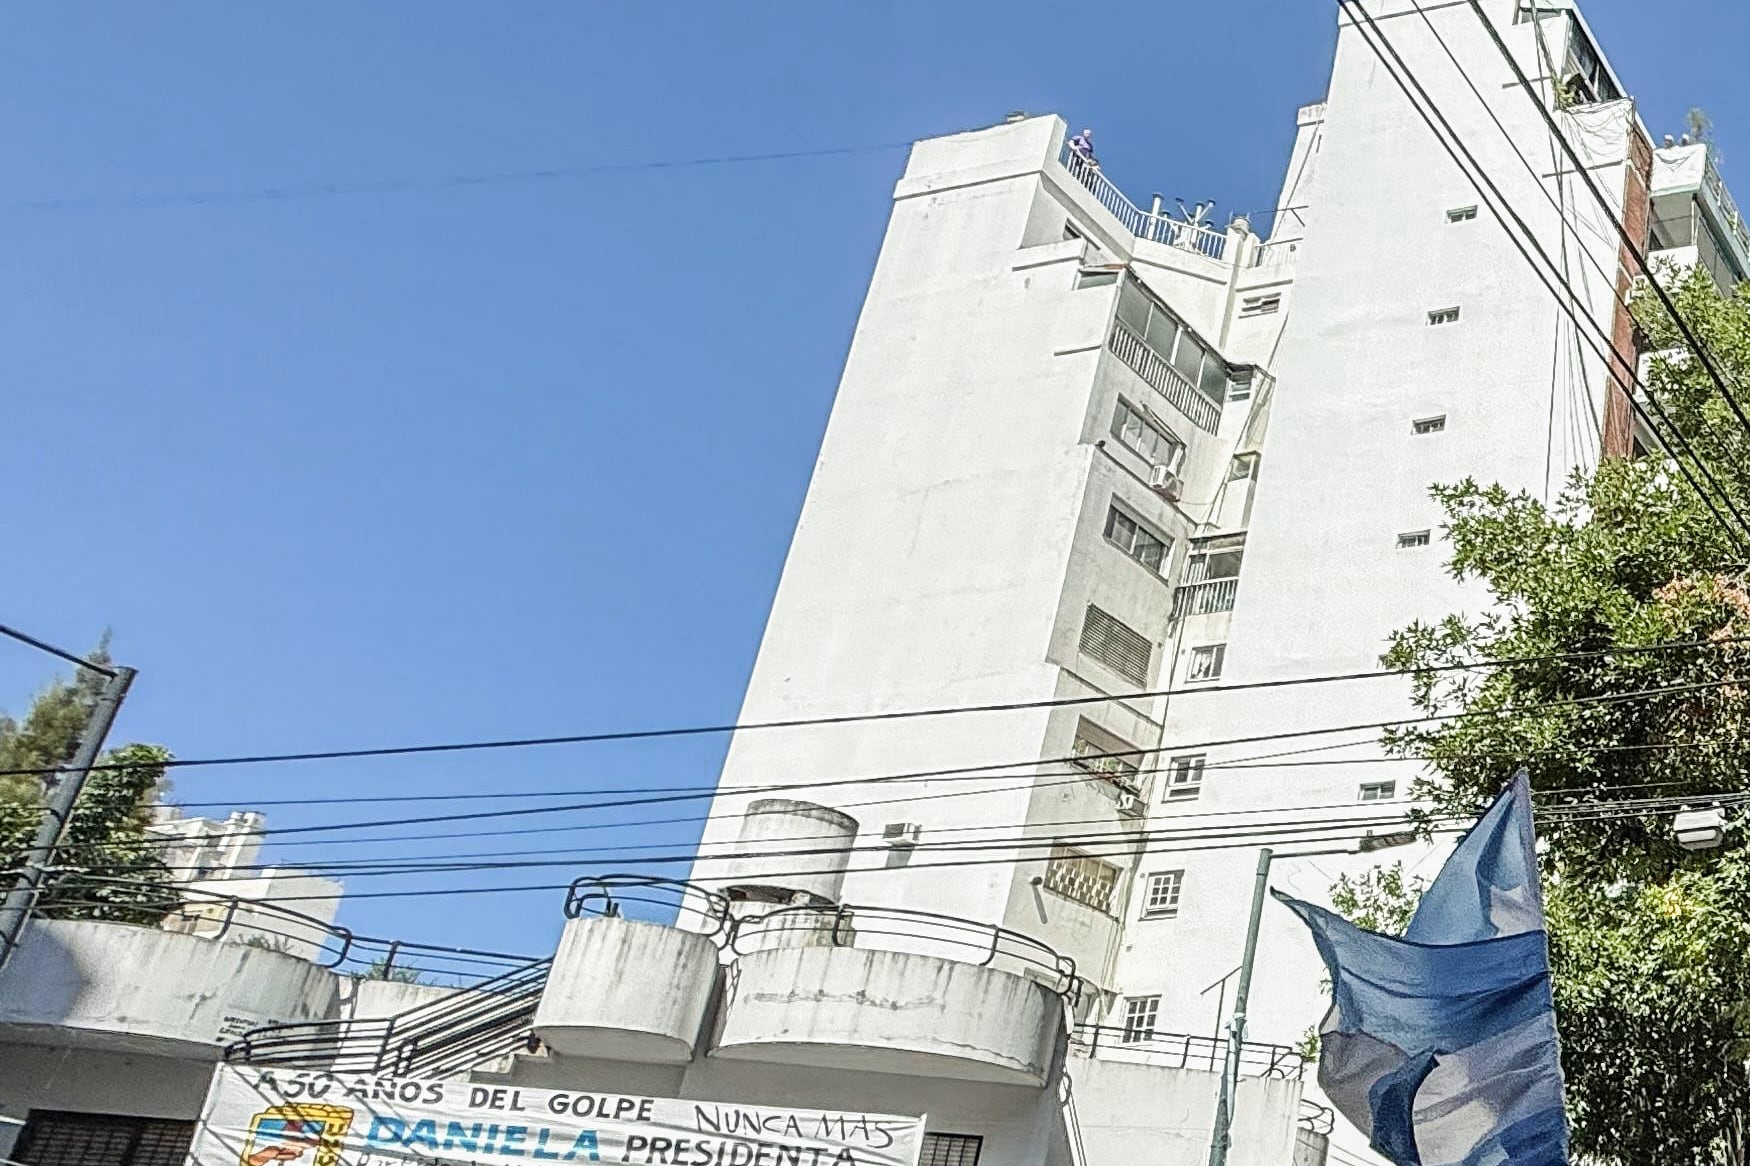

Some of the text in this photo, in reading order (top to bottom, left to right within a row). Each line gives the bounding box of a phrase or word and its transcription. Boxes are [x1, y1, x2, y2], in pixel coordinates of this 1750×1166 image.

[284, 1073, 334, 1098] 50
[468, 1088, 526, 1112] DEL
[548, 1093, 655, 1122] GOLPE
[694, 1104, 801, 1138] NUNCA
[366, 1115, 600, 1161] DANIELA
